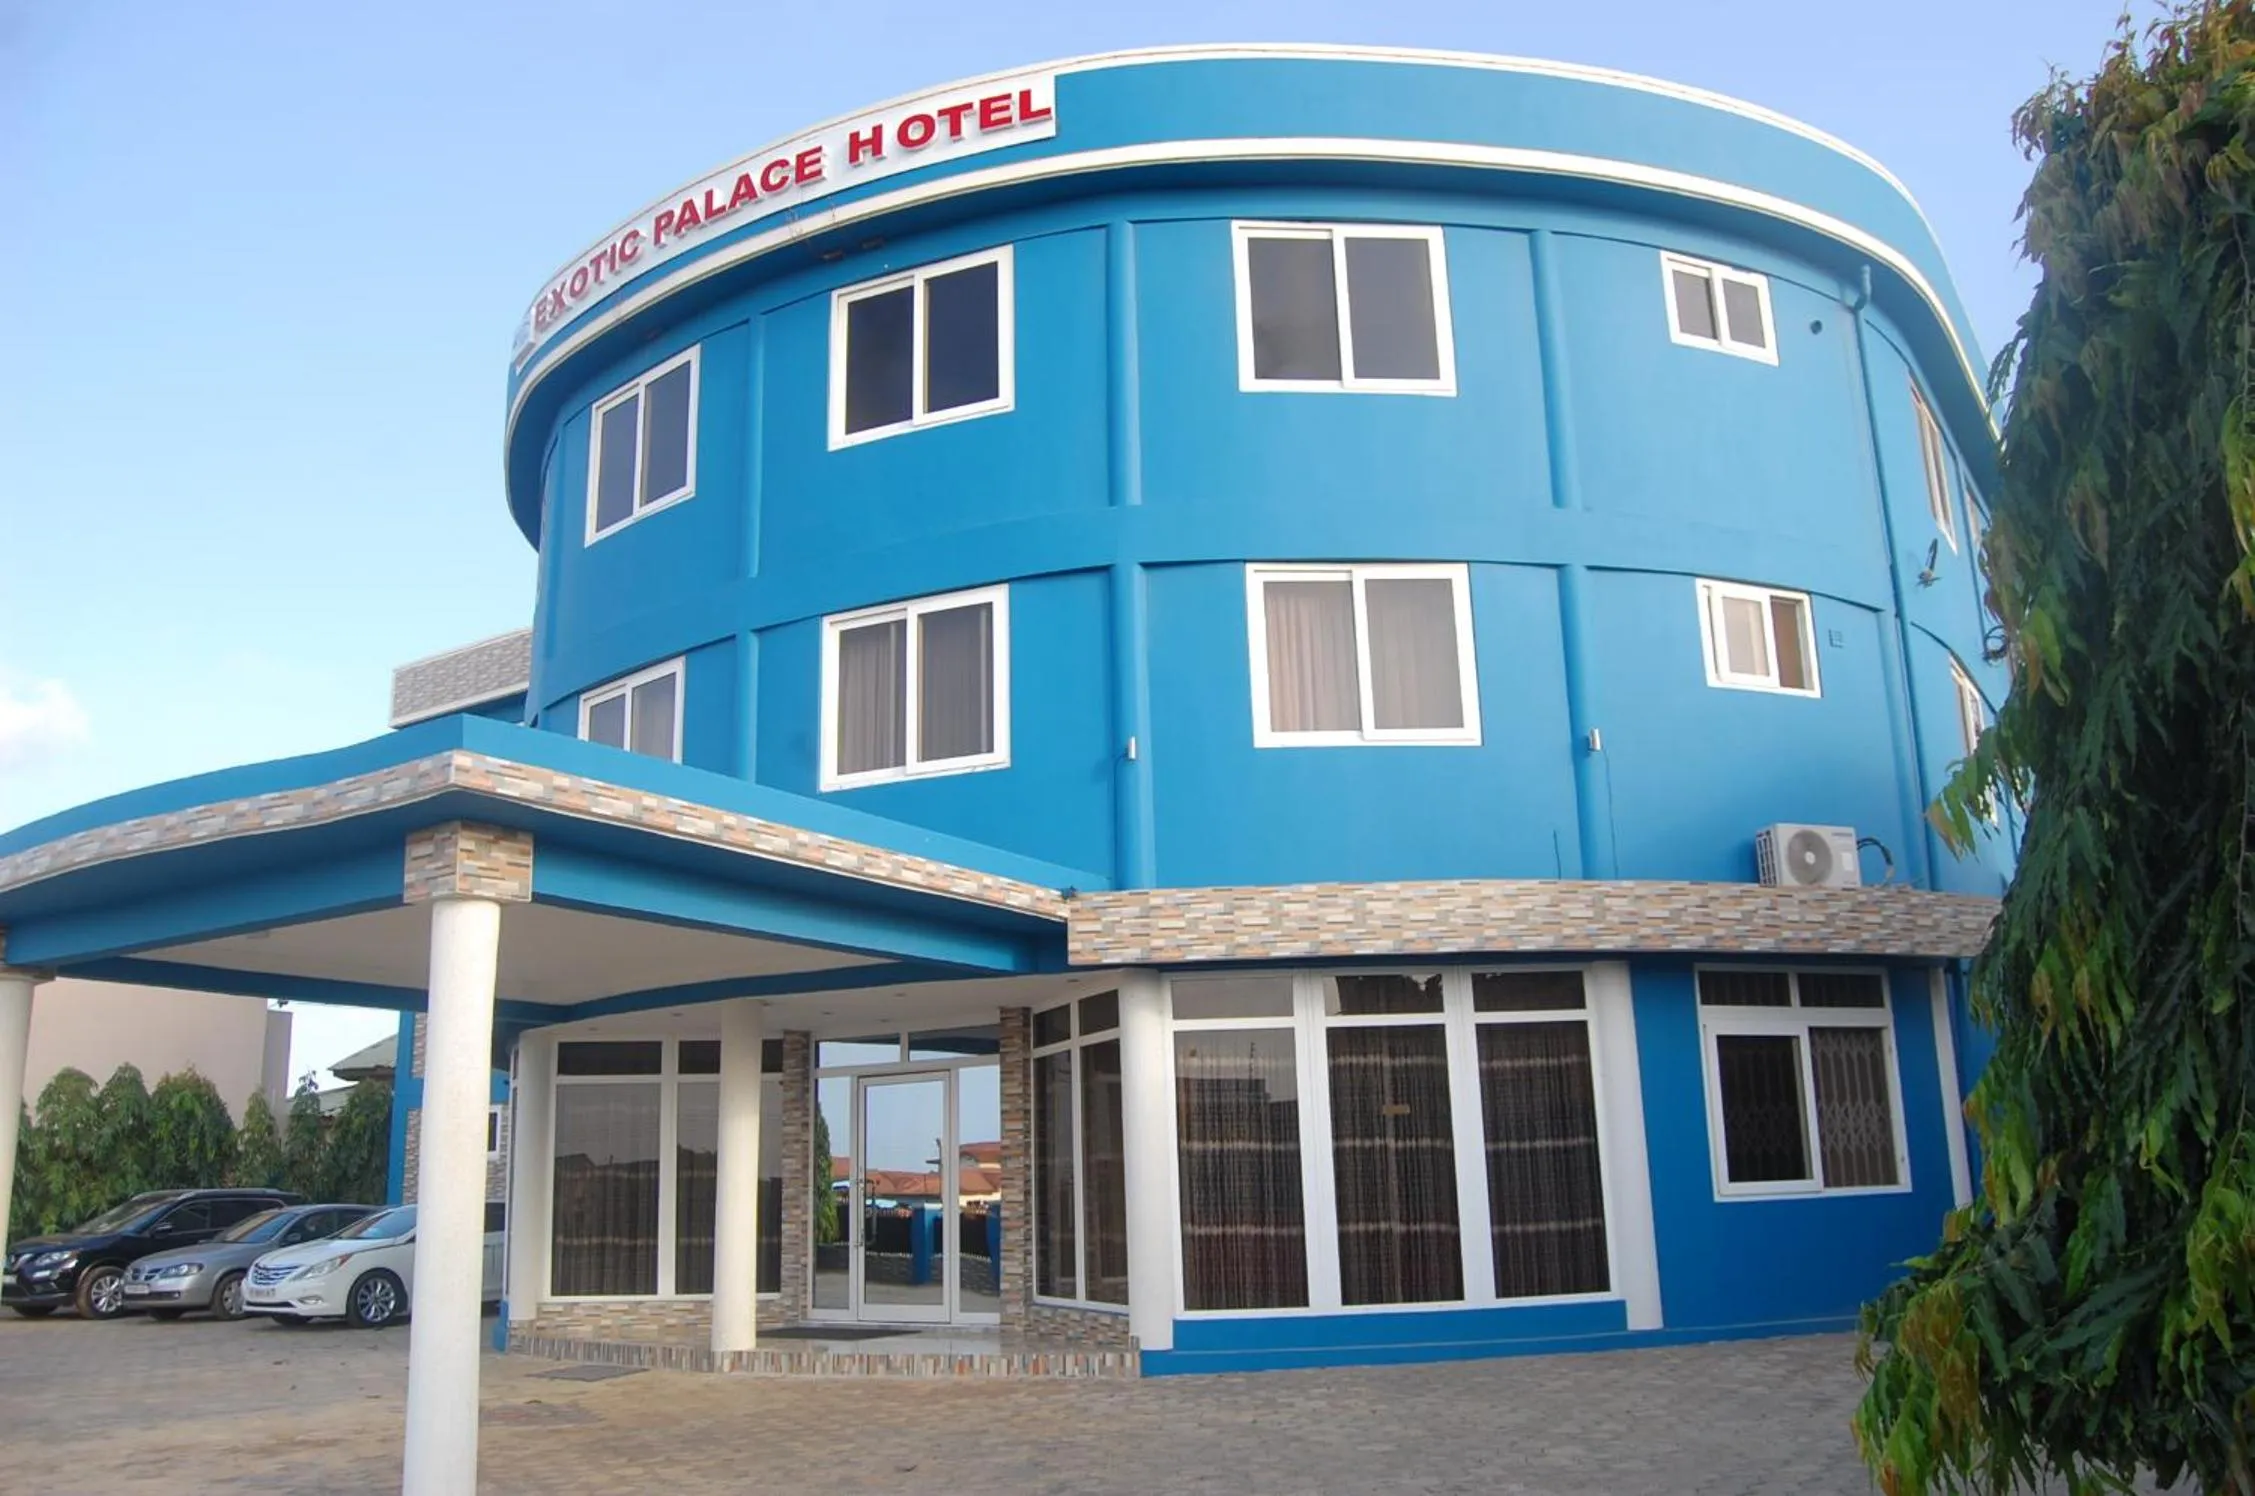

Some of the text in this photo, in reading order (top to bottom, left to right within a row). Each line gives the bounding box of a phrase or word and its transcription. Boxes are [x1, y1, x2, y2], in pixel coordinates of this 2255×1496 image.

[534, 89, 1052, 330] EXOTIC PALACE HOTEL
